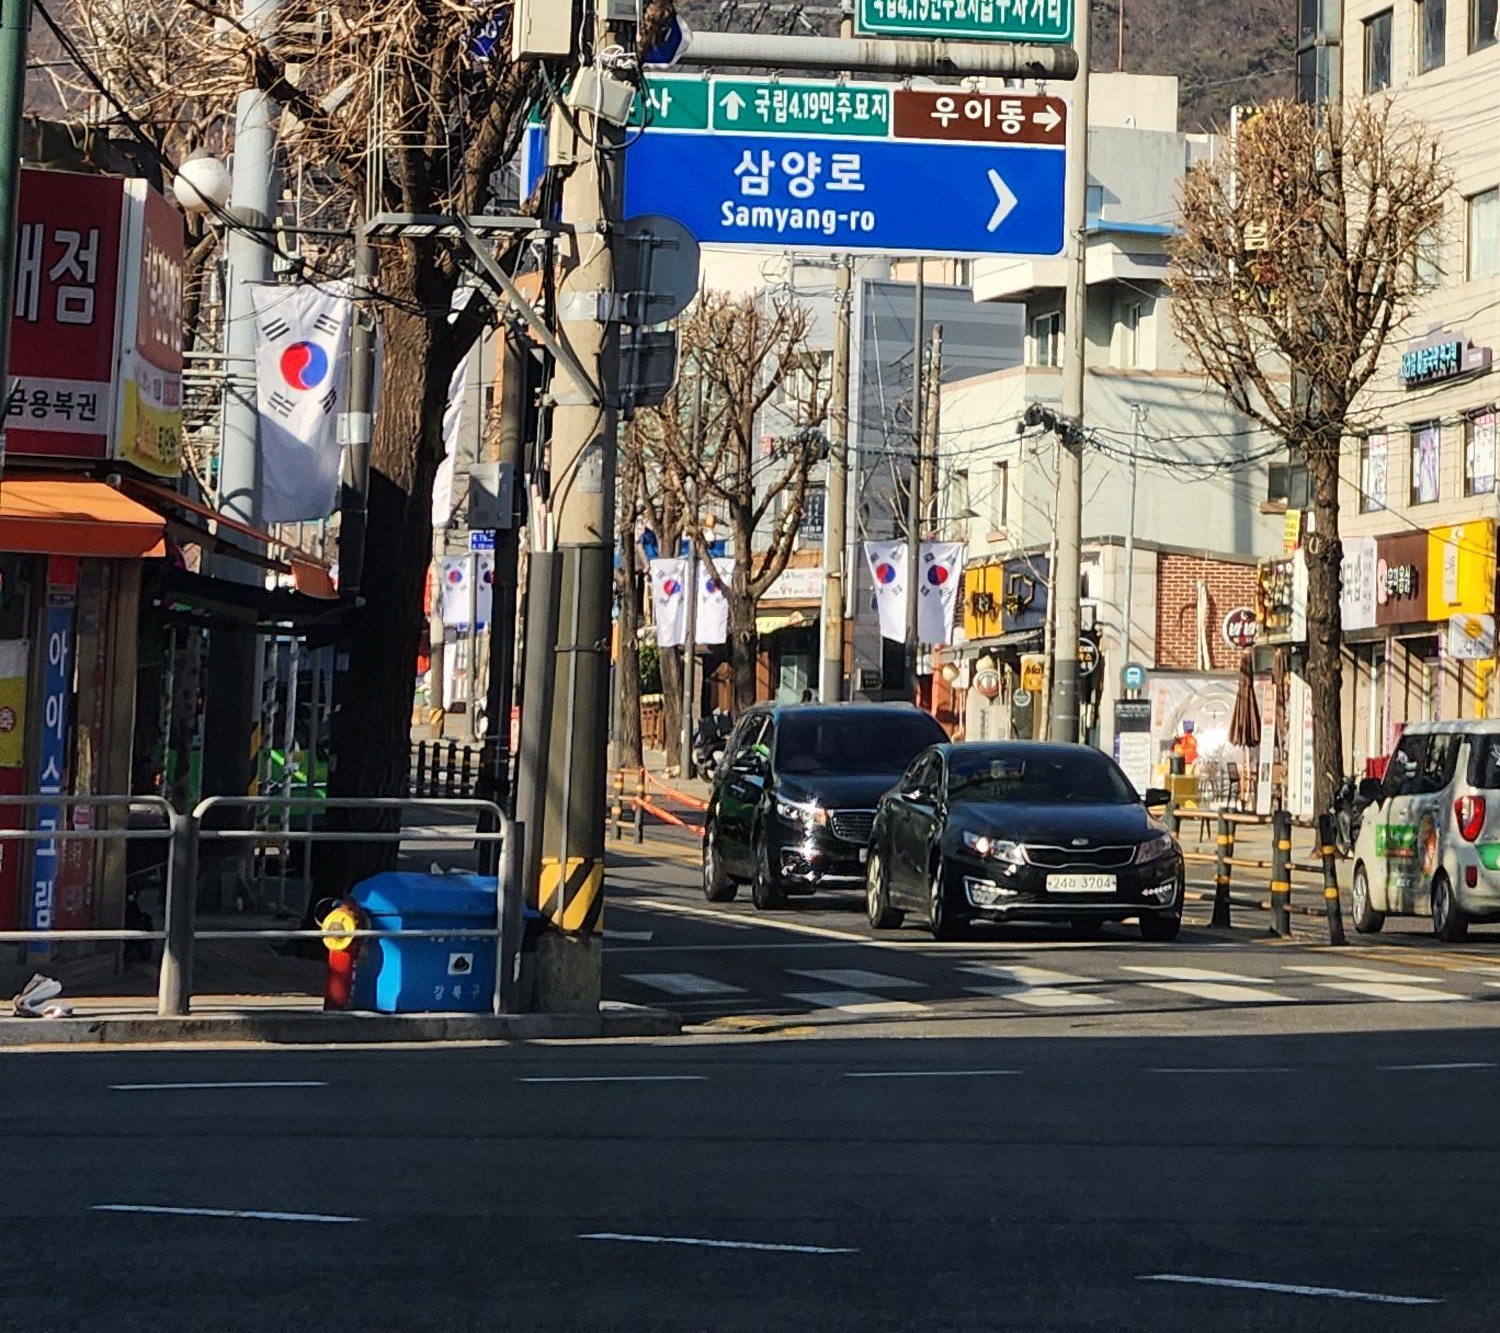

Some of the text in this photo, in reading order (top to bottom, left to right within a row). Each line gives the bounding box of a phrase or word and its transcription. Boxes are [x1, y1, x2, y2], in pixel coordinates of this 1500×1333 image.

[754, 88, 888, 124] 국립4.19민주묘지
[930, 96, 1026, 134] 우이동
[733, 149, 866, 199] 삼양로
[721, 200, 876, 235] Samyang-ro
[1081, 876, 1111, 889] 3704
